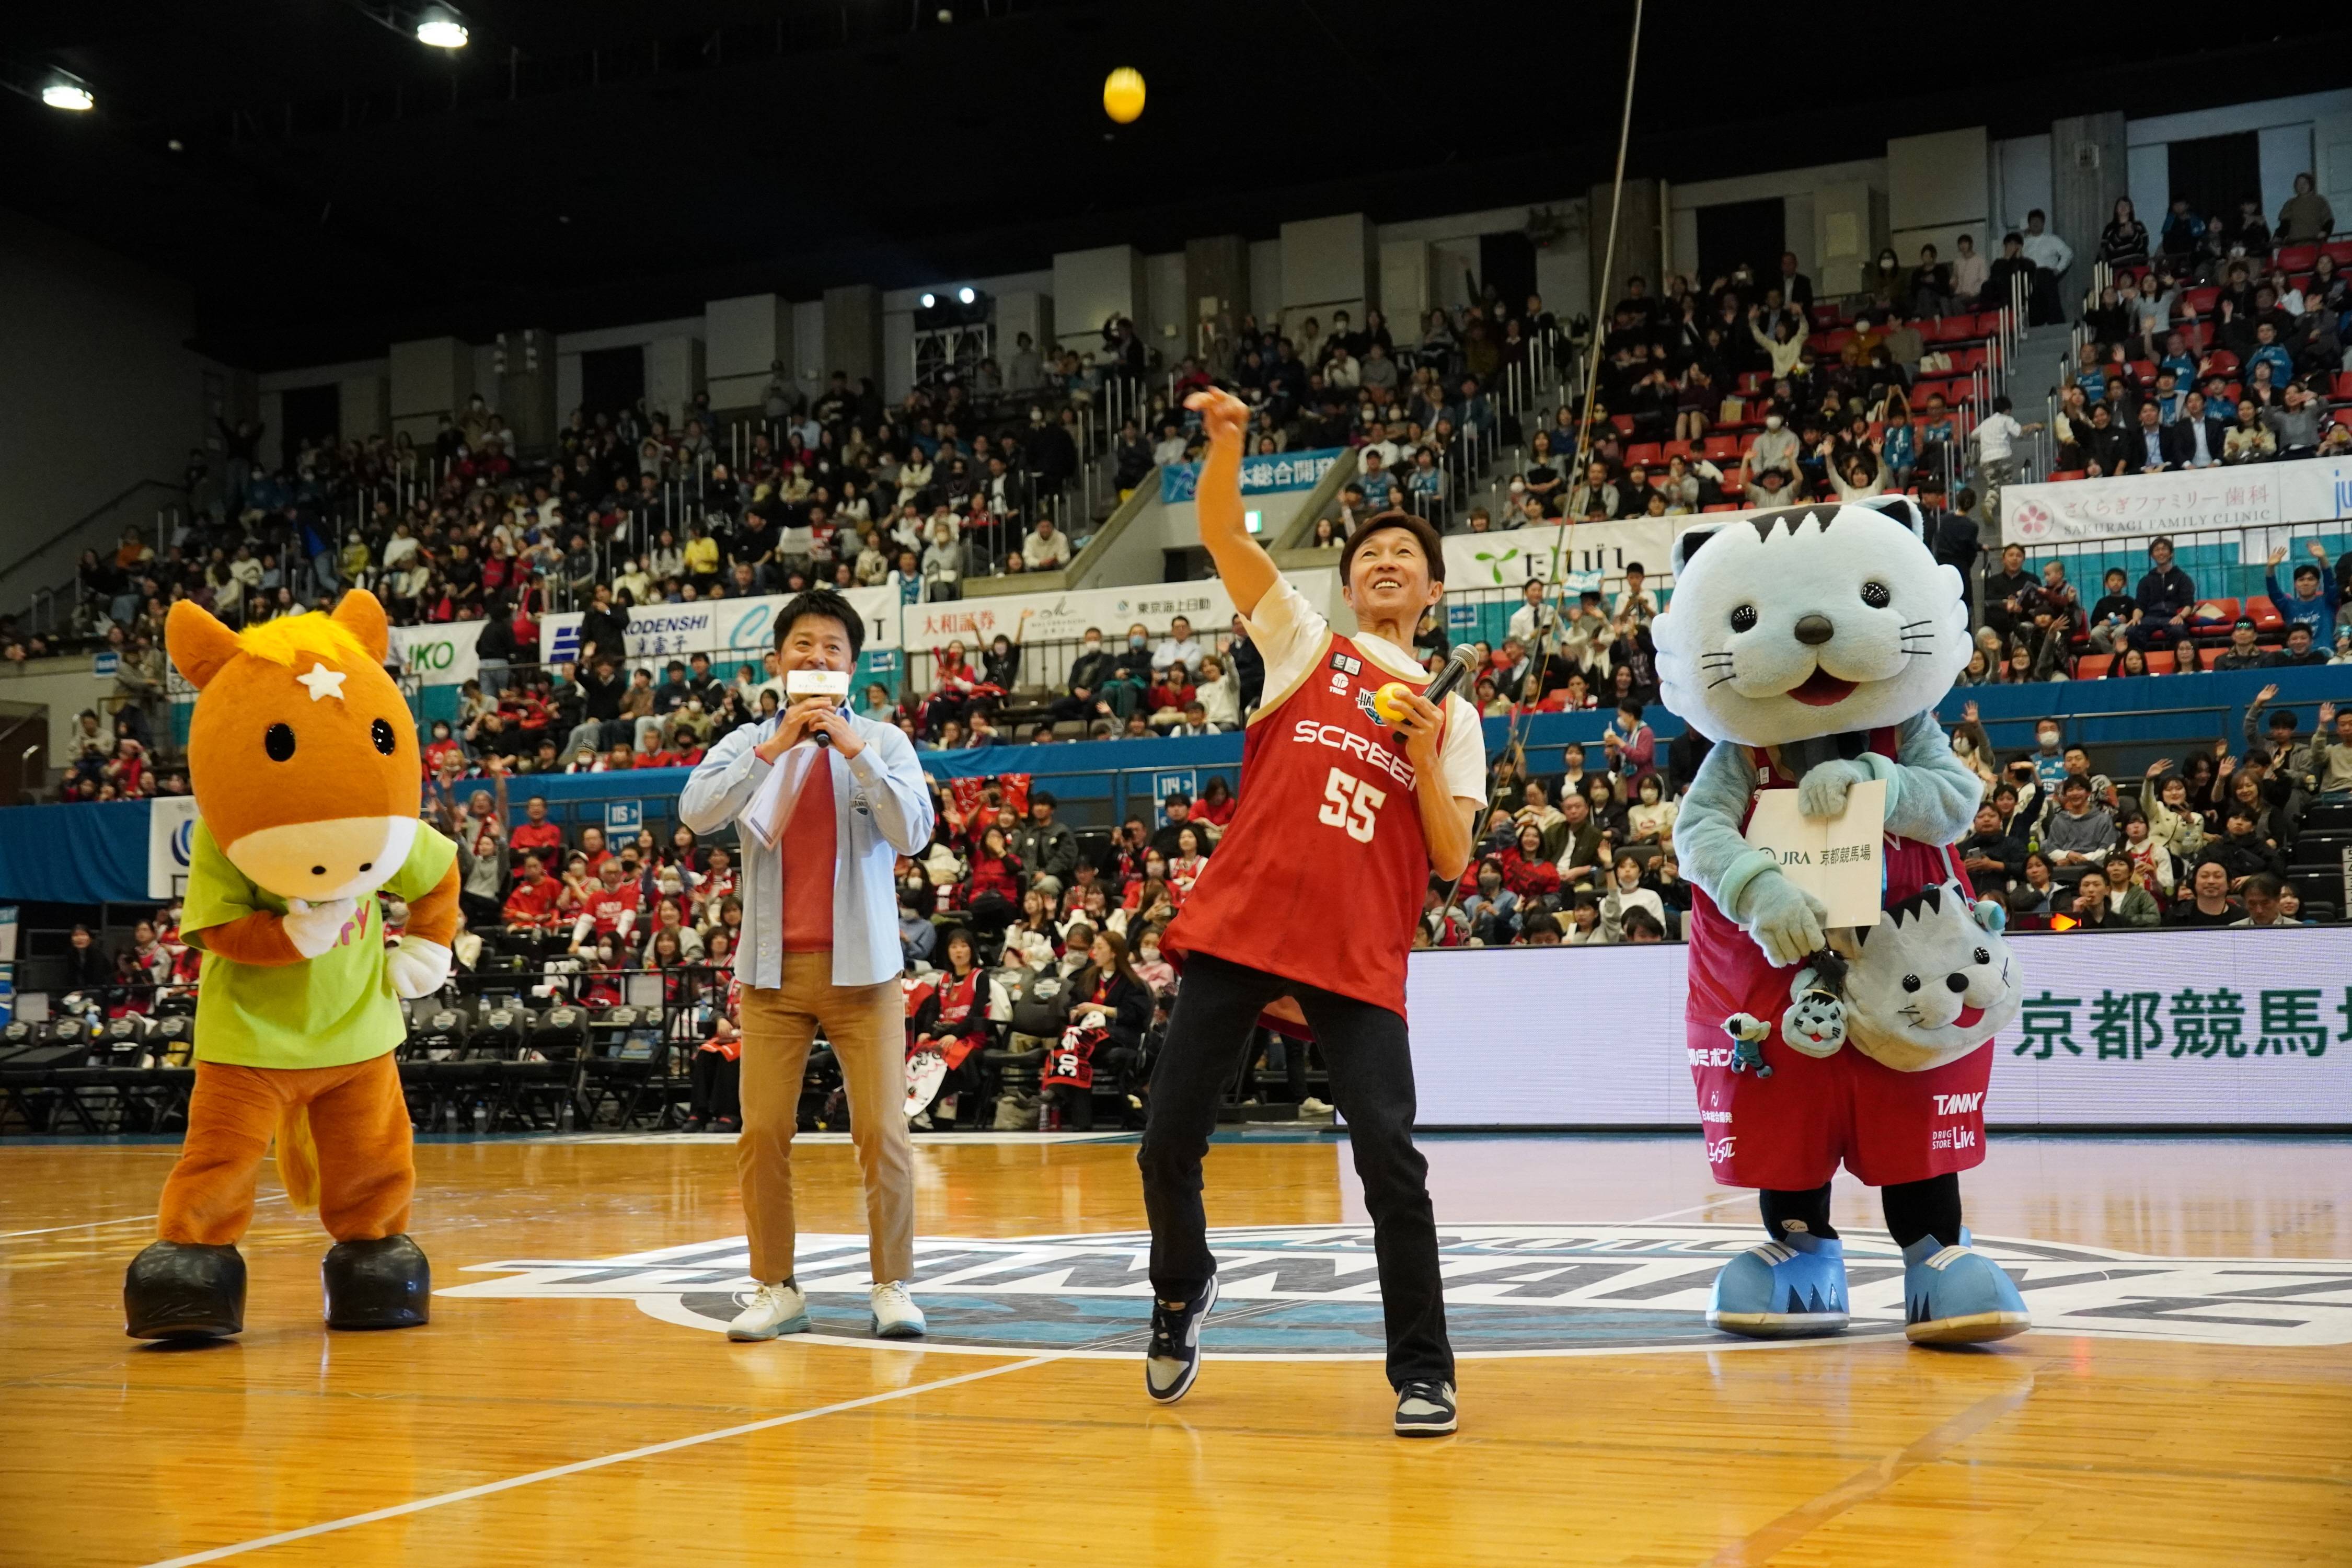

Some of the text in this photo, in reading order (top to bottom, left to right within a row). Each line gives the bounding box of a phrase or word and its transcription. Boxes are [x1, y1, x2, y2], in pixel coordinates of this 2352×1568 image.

[2063, 483, 2269, 518] さくらぎファミリー歯科
[2064, 509, 2270, 535] SAKURAGI FAMILY CLINIC
[1138, 597, 1211, 615] 東京海上日動
[625, 614, 709, 635] ODENSHI
[1318, 766, 1387, 844] 55
[1780, 844, 1871, 866] JRA 京都競馬場
[1688, 1048, 1735, 1067] ルミポン
[1933, 1091, 1984, 1116] TANNY
[1701, 1110, 1733, 1123] 日本総合開発
[1932, 1139, 1952, 1150] STORE
[1933, 1129, 1952, 1140] DRUG
[1953, 1125, 1975, 1149] Live
